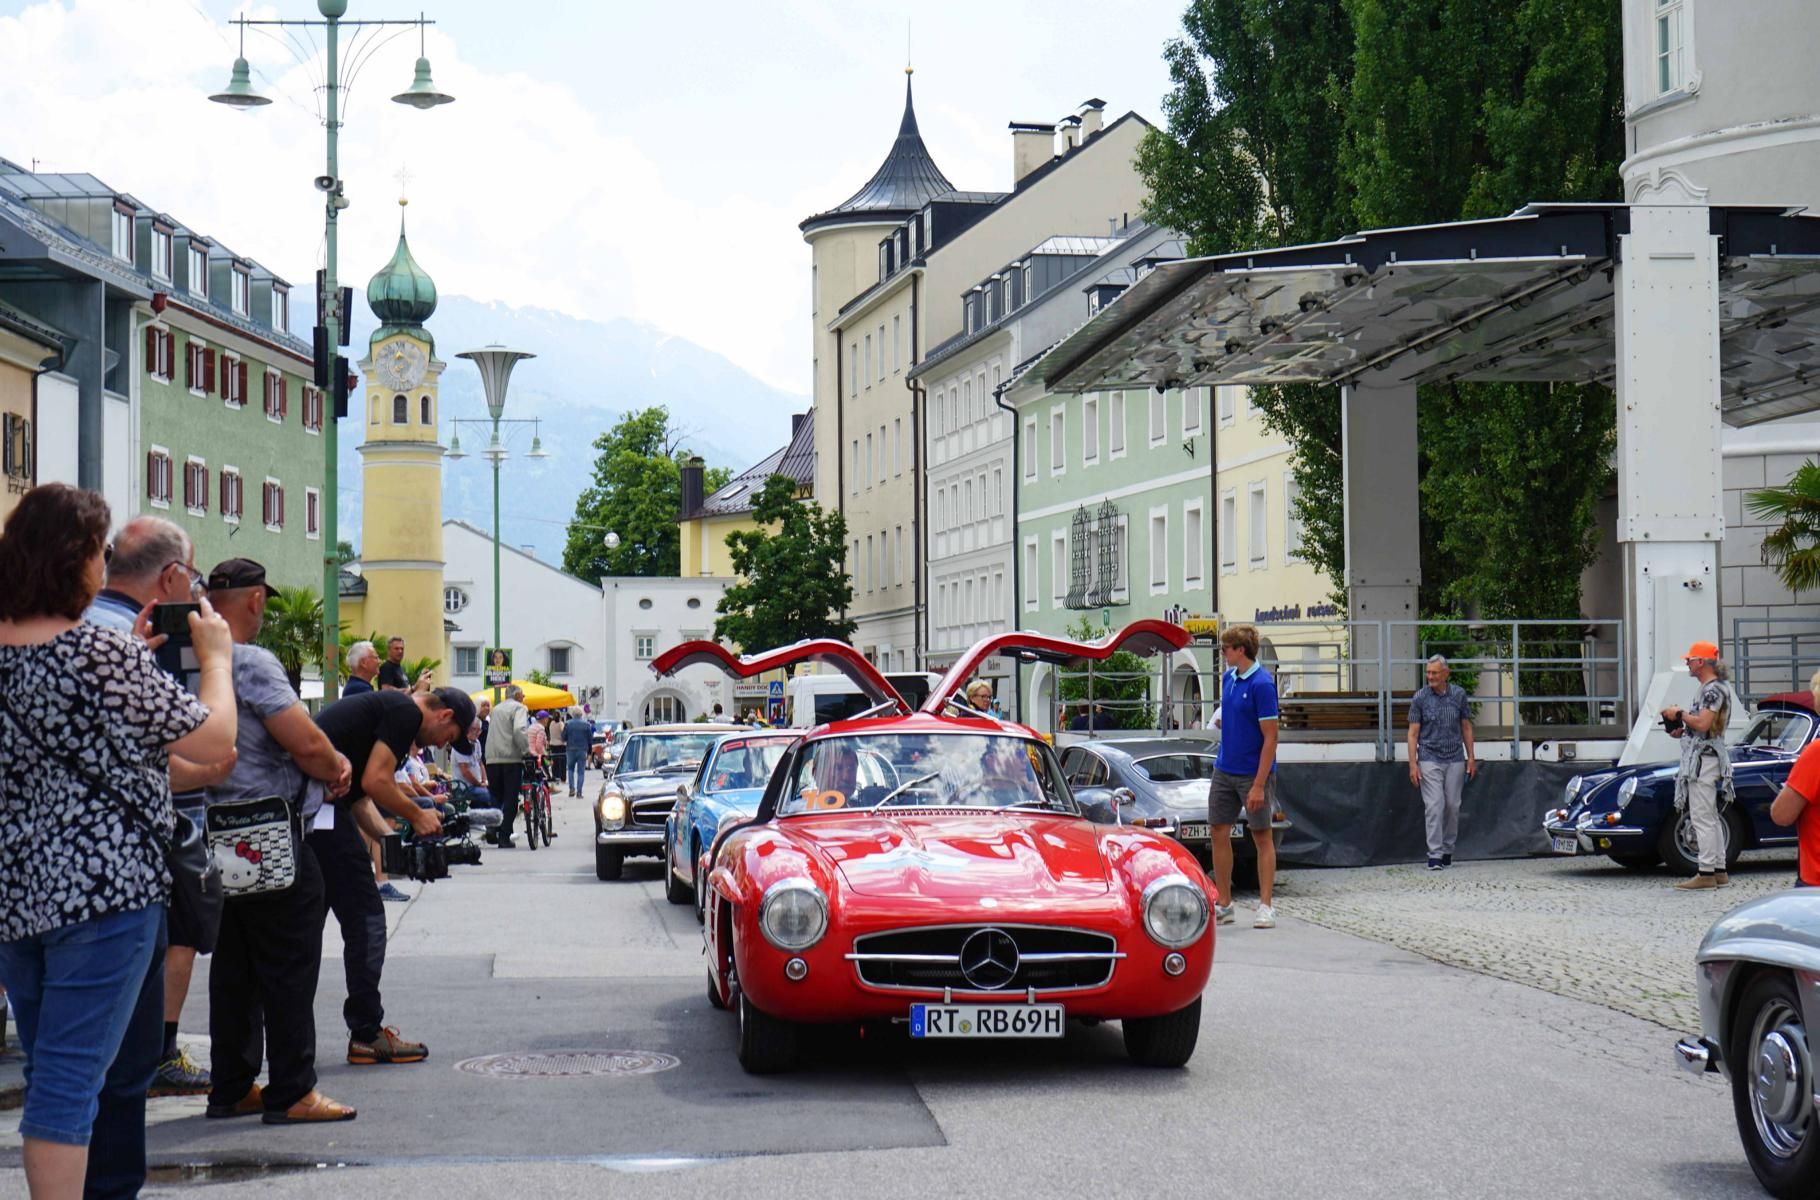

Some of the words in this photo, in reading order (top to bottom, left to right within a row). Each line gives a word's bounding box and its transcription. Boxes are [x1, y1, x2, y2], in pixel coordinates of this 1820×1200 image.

[801, 789, 846, 811] 10
[927, 1009, 960, 1034] RT
[976, 1009, 1061, 1034] RB69H
